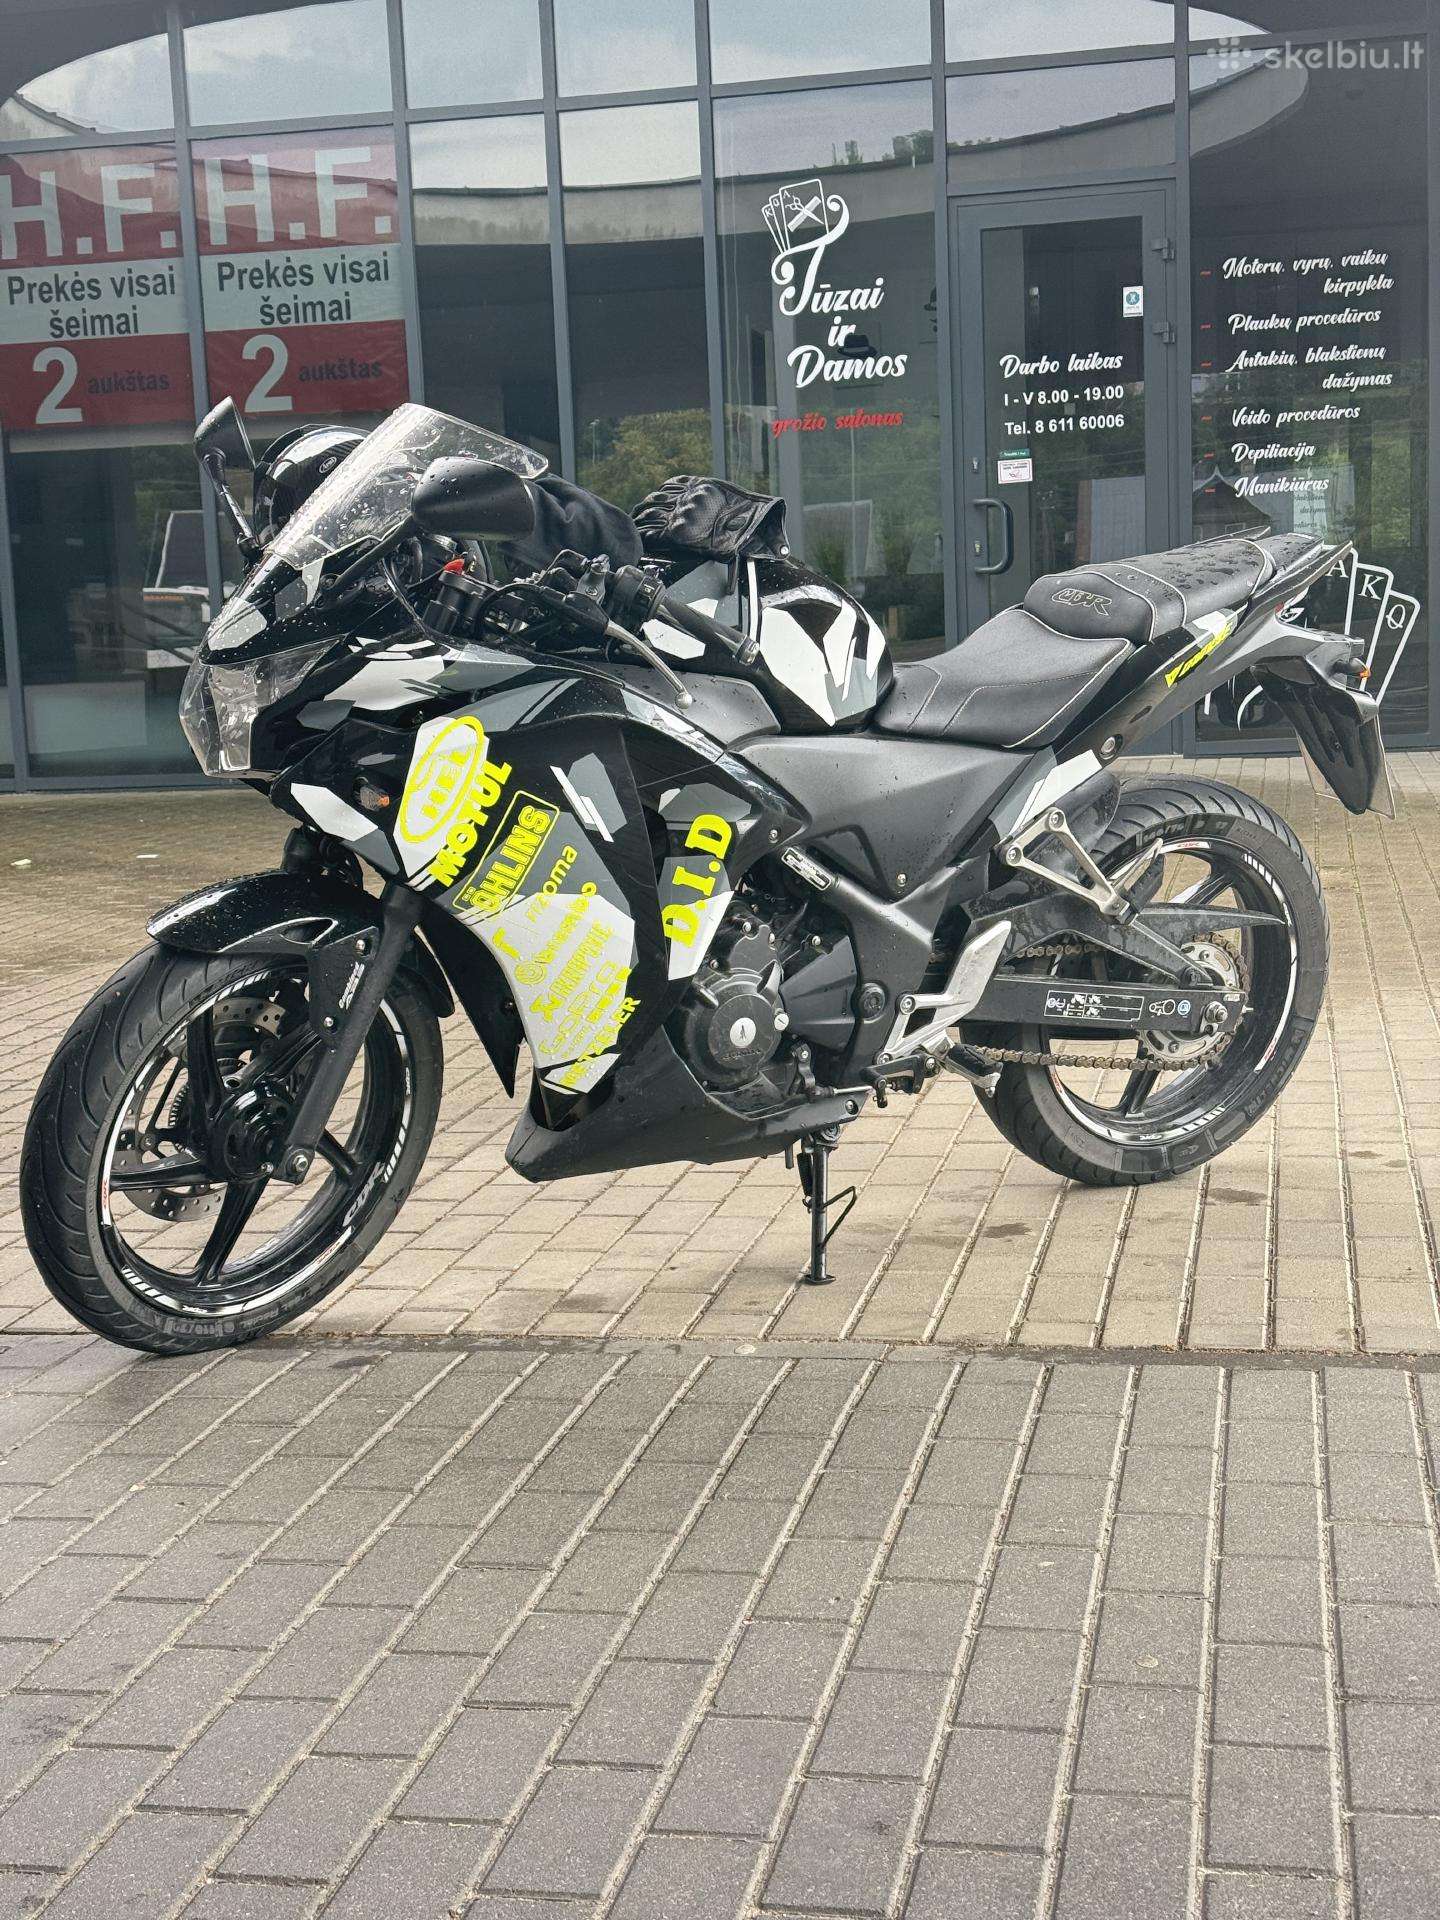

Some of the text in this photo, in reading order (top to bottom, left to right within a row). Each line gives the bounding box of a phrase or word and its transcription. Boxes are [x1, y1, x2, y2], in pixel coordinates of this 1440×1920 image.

[0, 163, 177, 260] H.F.
[205, 147, 392, 246] H.F.
[7, 265, 176, 305] Prekės visai
[217, 251, 390, 291] Prekės visai
[1323, 274, 1394, 297] kirpykla
[49, 305, 139, 339] šeimai
[259, 292, 352, 326] šeimai
[1295, 308, 1382, 332] procedūros
[828, 316, 857, 347] ir
[241, 334, 383, 413] 2 aukštas
[787, 344, 908, 388] Damos
[999, 352, 1124, 378] Darbo laikas
[32, 346, 170, 425] 2 aukštas
[1023, 391, 1034, 405] V
[1037, 389, 1069, 404] 8.00
[1084, 385, 1124, 401] 19.00
[1322, 372, 1393, 392] dažymas
[1004, 414, 1125, 435] Tel. 8 611 60006
[1232, 404, 1361, 428] Veido procedūros
[1231, 442, 1316, 464] Depiliacija
[1234, 476, 1330, 498] Manikiūras
[1358, 574, 1385, 600] K
[1385, 604, 1407, 630] Q
[428, 761, 512, 887] MOTUL
[461, 805, 551, 912] ÖHLINS
[661, 814, 733, 948] D.I.D
